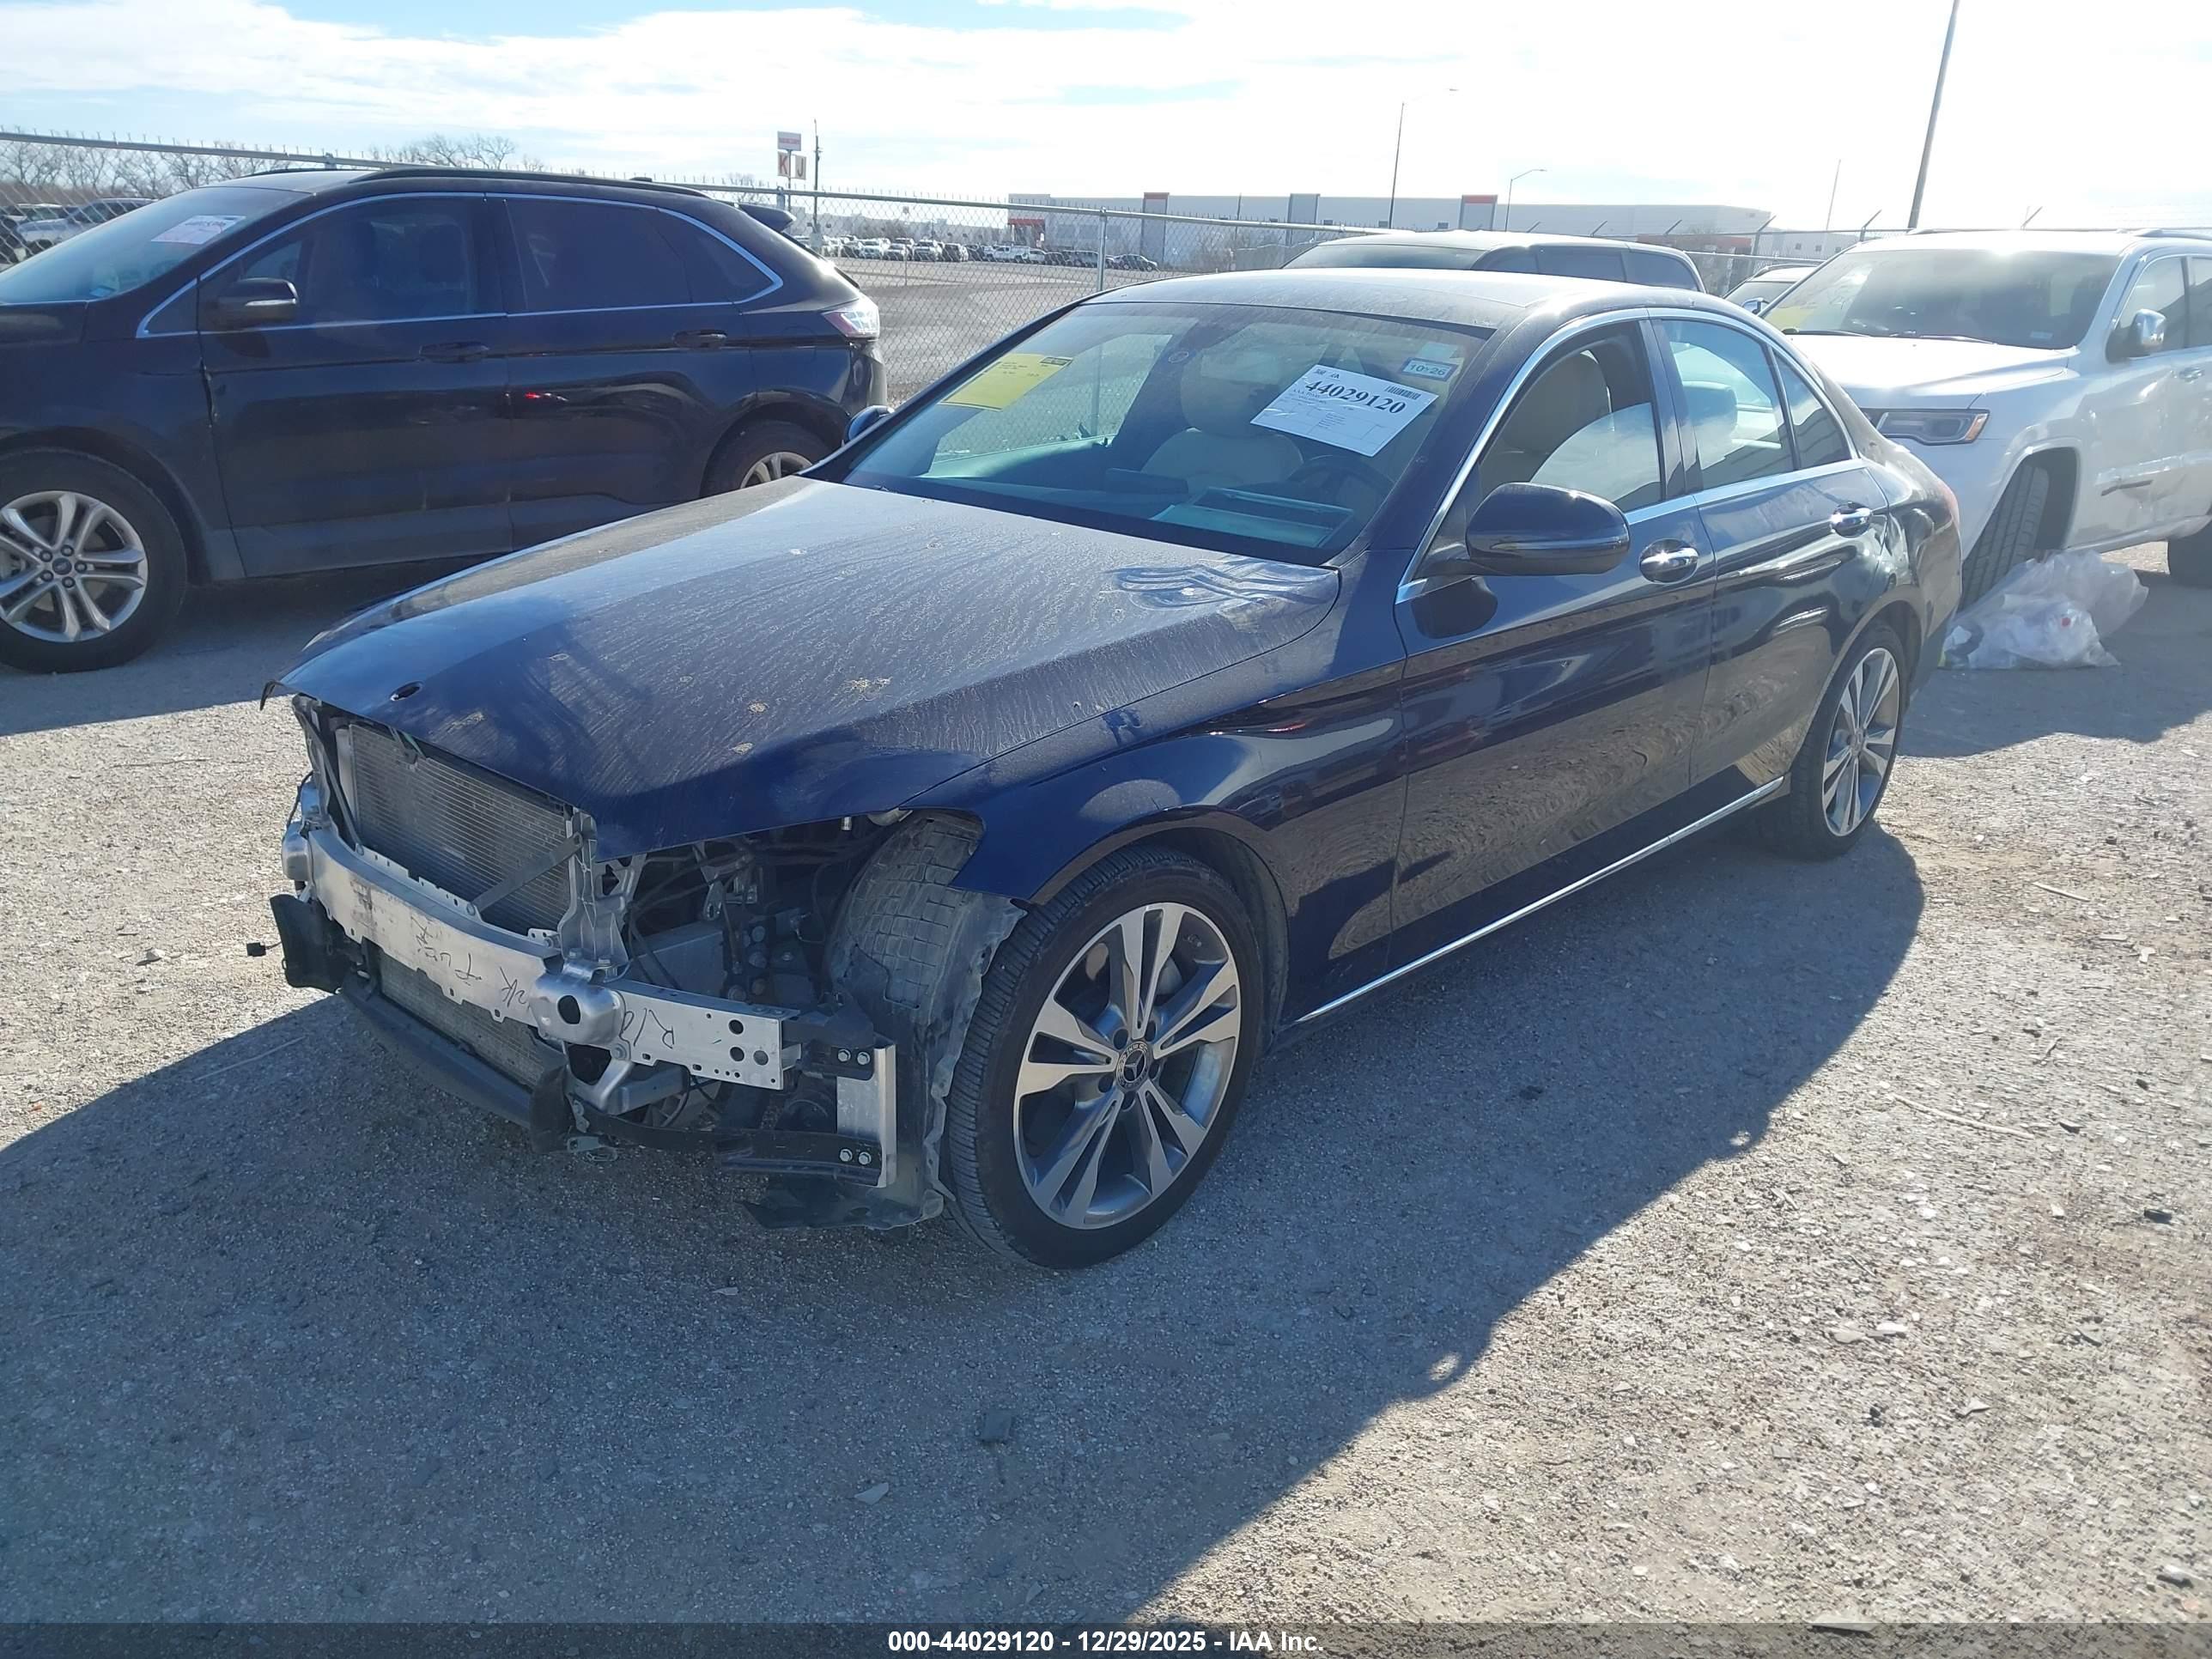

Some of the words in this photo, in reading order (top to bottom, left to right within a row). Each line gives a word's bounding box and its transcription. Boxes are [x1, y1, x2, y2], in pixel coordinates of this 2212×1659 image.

[779, 155, 788, 175] K
[797, 157, 804, 178] J
[1305, 380, 1407, 414] 44029120
